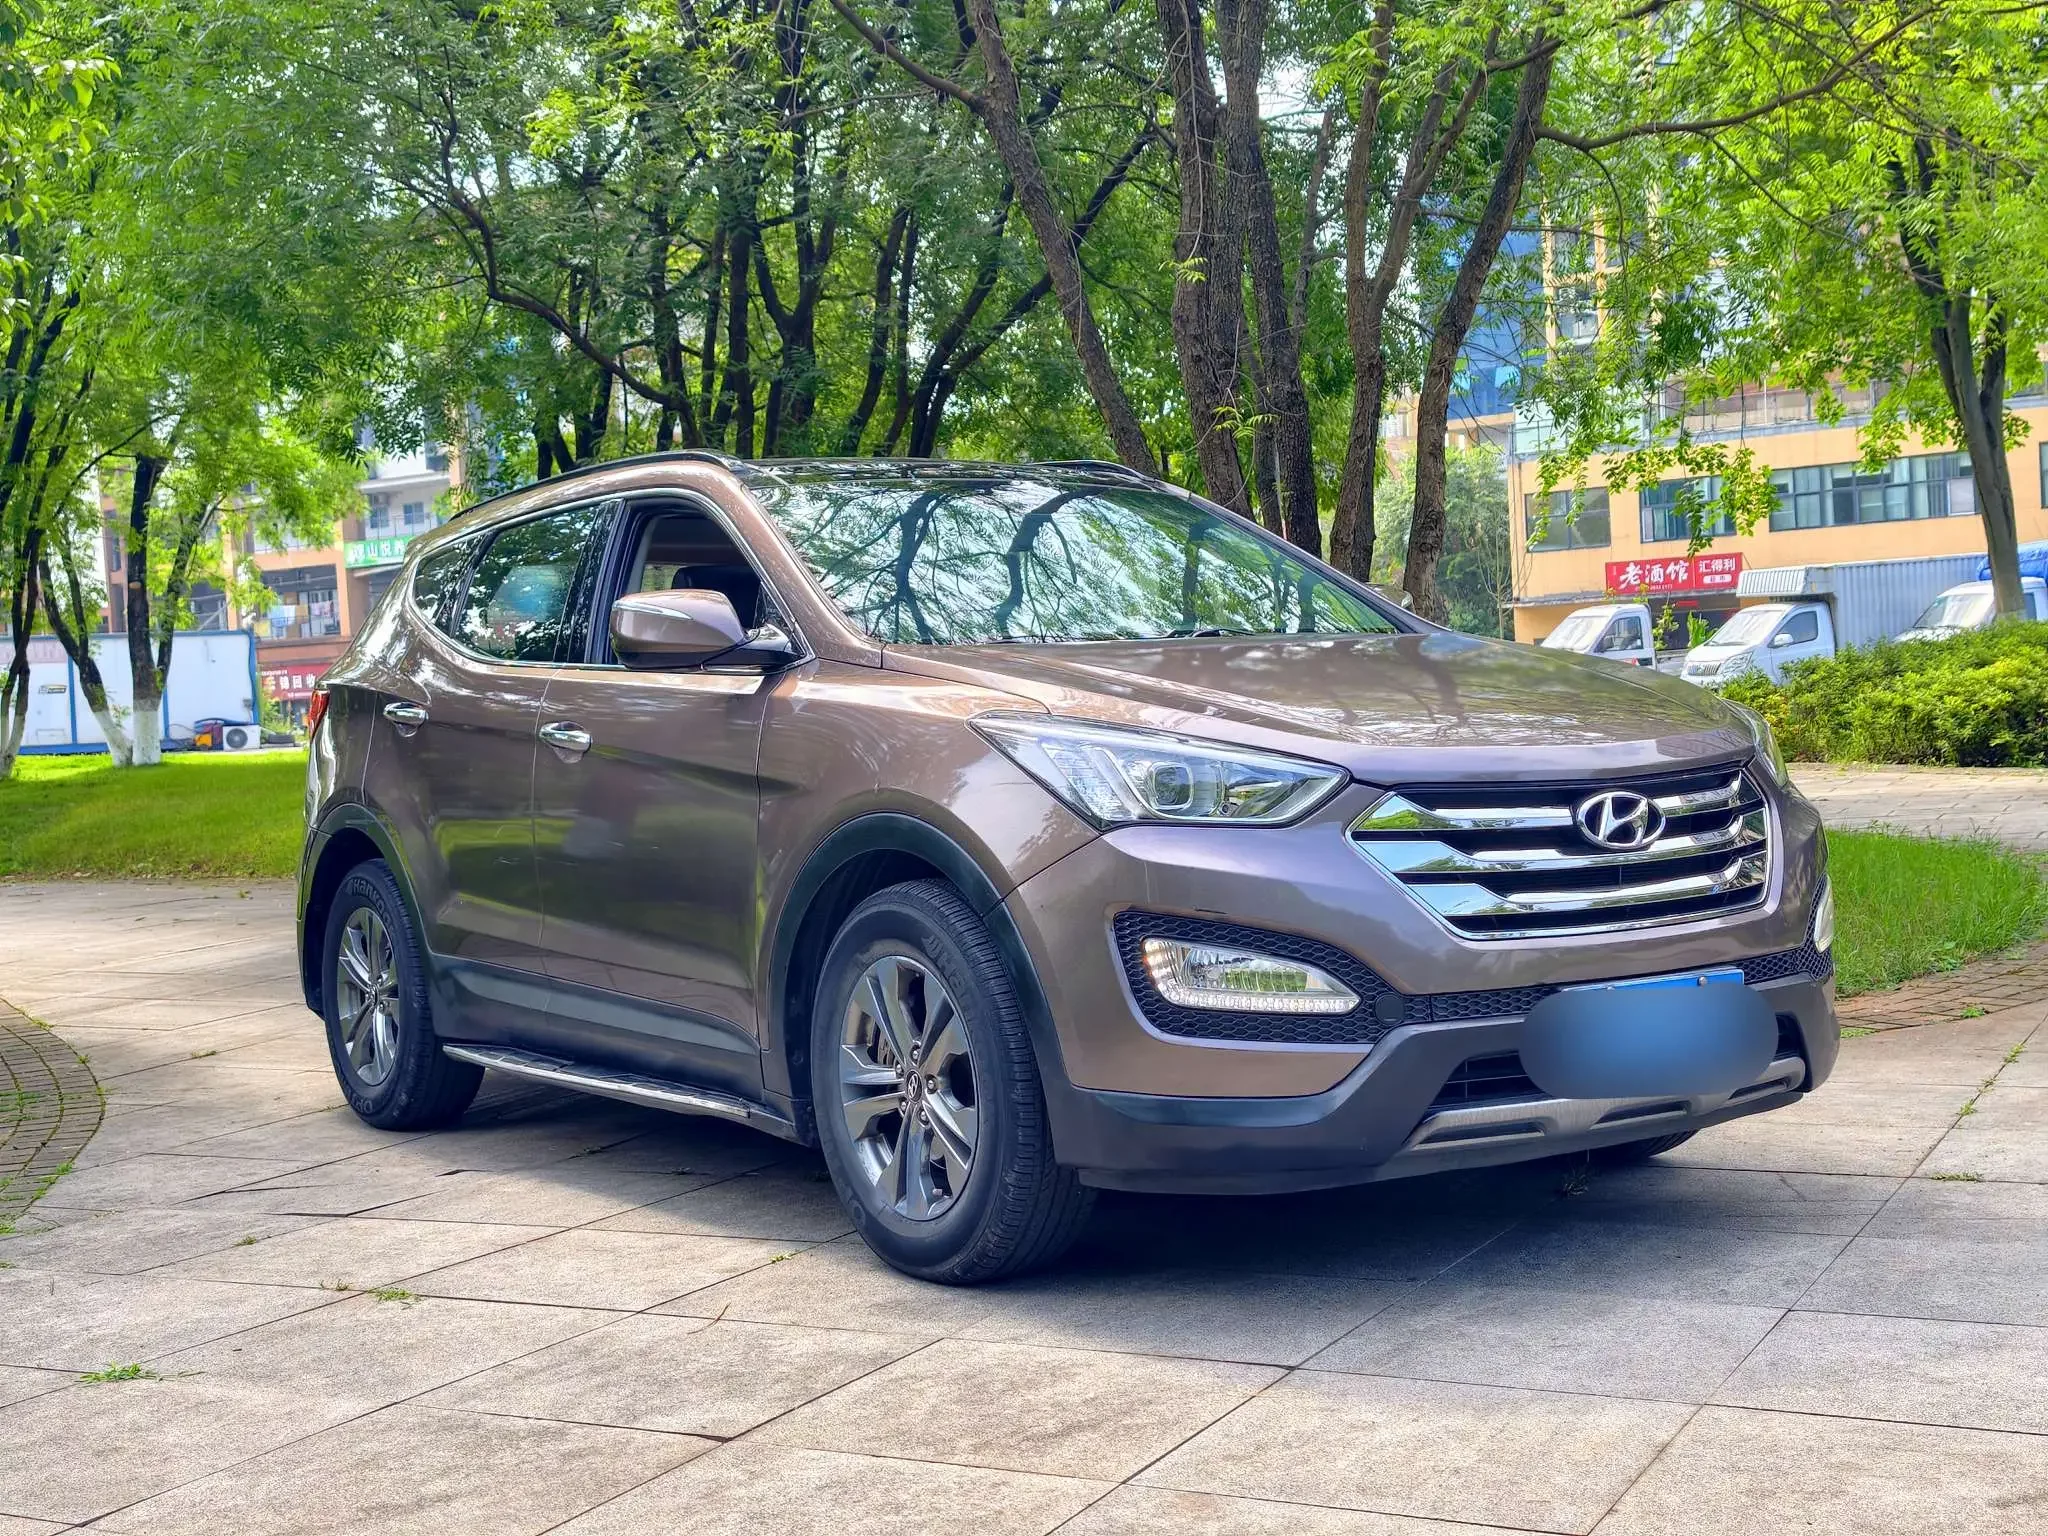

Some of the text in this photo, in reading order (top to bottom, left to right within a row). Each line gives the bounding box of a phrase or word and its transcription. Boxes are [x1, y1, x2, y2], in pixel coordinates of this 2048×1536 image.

[1619, 560, 1689, 588] 老酒馆
[1699, 558, 1736, 573] 汇得利
